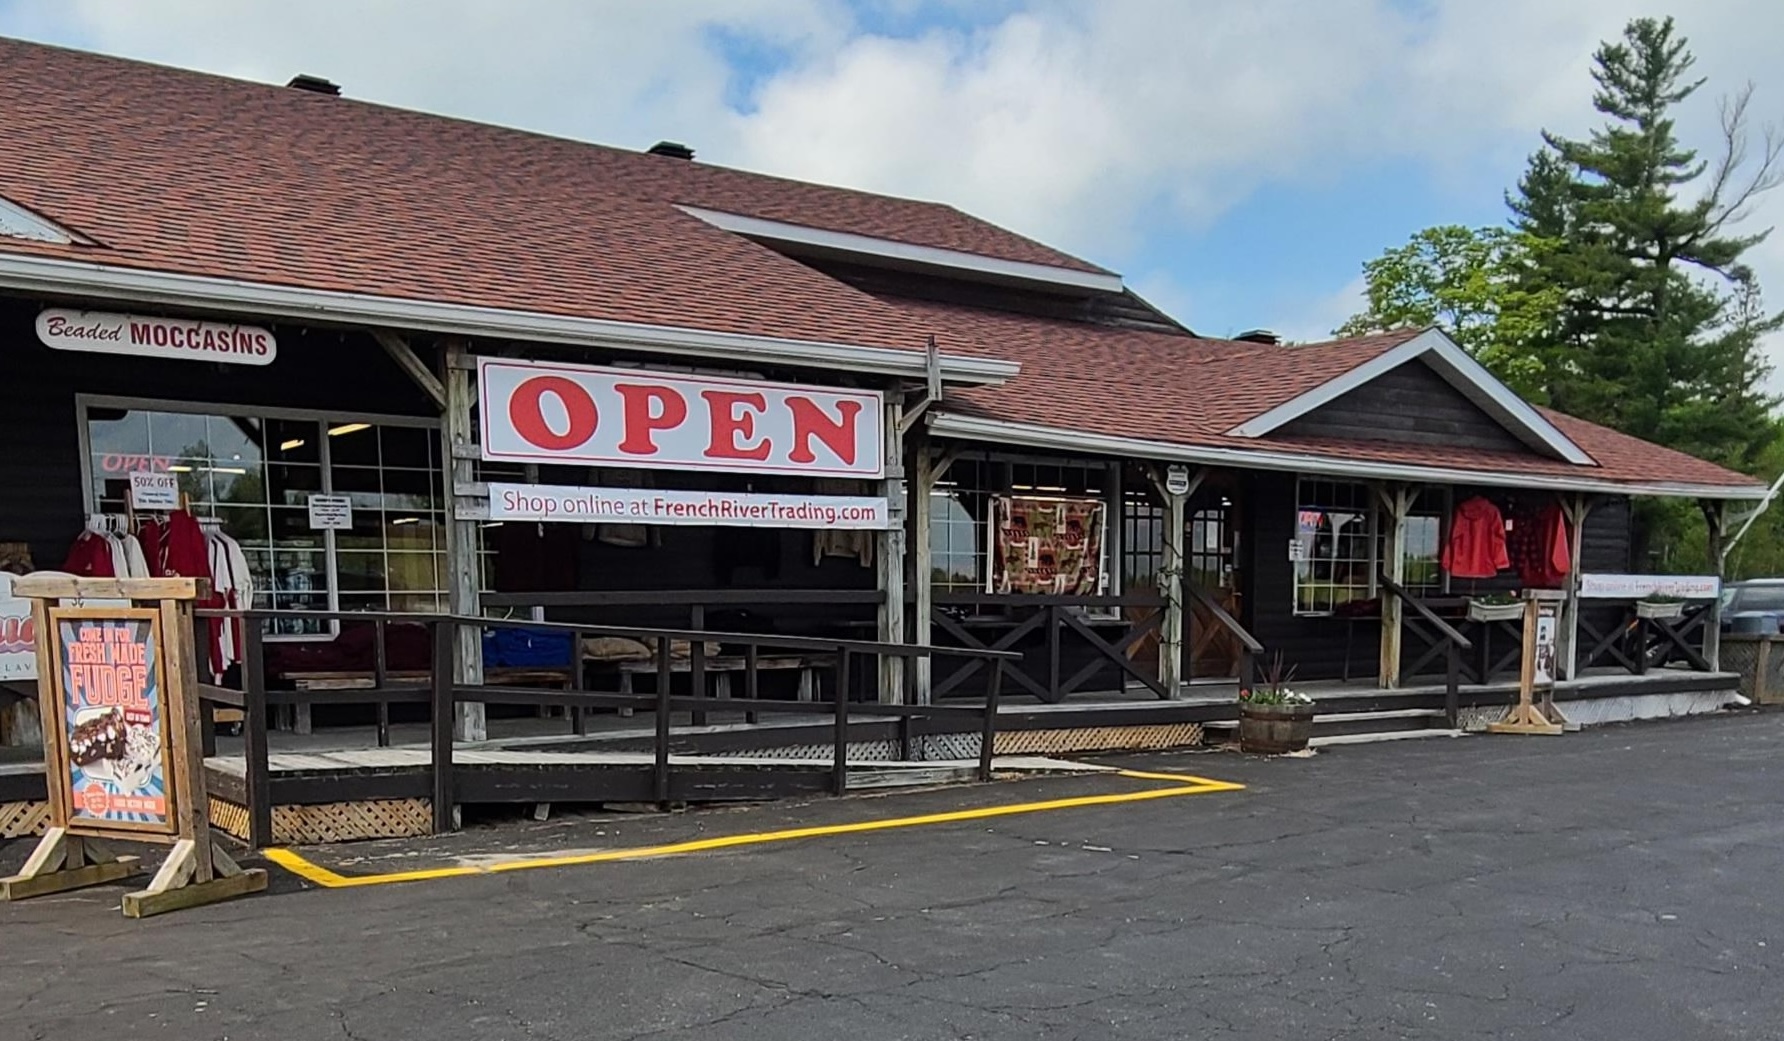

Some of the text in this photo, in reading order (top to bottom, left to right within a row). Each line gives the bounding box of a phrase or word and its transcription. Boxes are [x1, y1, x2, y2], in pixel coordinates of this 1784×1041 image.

[46, 316, 268, 356] Beaded MOCCASINS
[508, 375, 863, 466] OPEN
[102, 454, 170, 473] OPEN
[134, 476, 174, 488] 50% OFF
[503, 490, 876, 524] Shop online at FrenchRiverTrading.com
[68, 642, 146, 665] FRESH MADE
[69, 664, 149, 706] FUDGE
